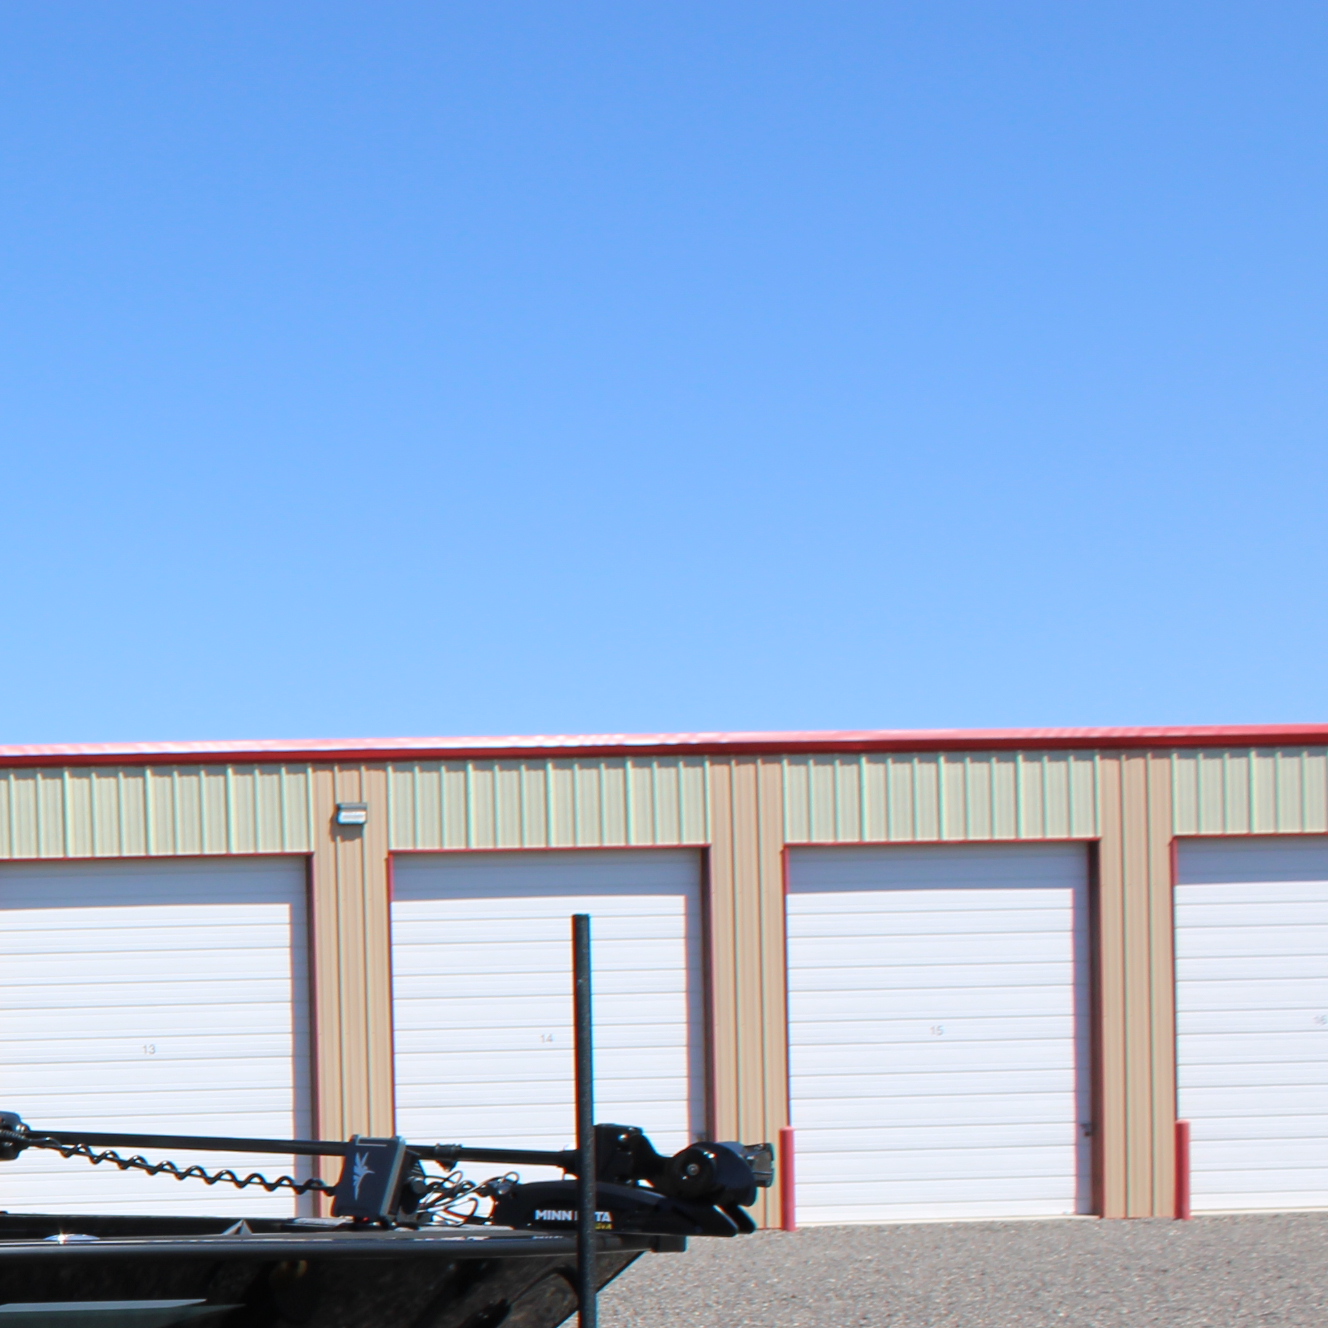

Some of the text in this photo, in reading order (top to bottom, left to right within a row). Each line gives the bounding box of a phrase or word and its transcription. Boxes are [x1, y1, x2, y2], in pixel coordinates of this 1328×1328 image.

[929, 1025, 944, 1036] 15
[540, 1033, 553, 1043] 14
[142, 1044, 156, 1055] 13
[534, 1209, 572, 1221] MINN
